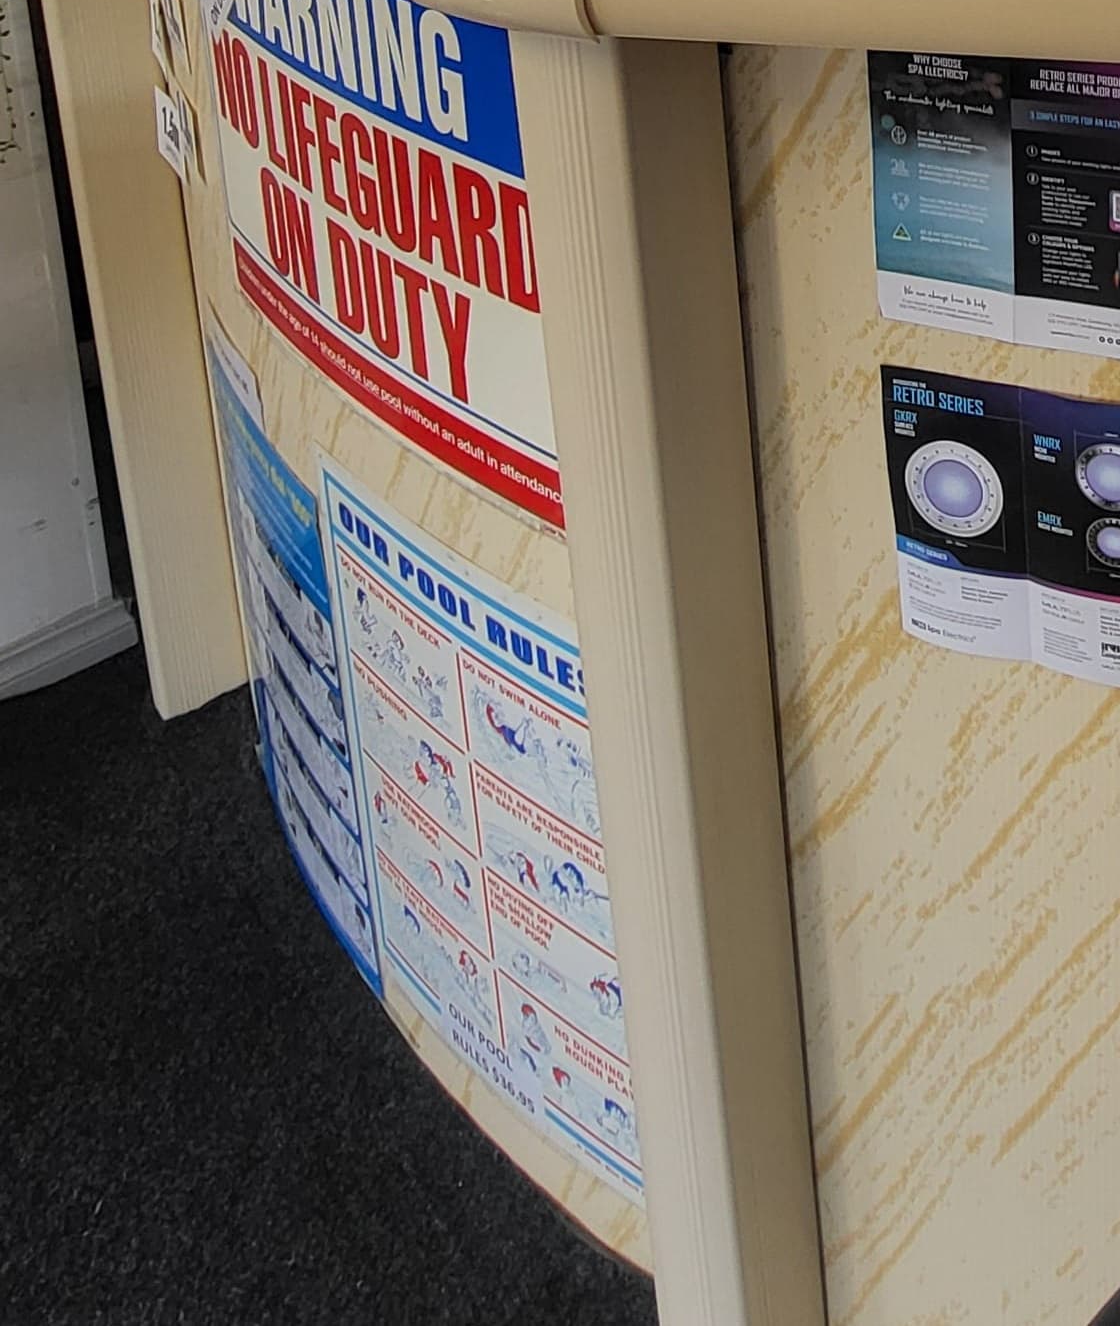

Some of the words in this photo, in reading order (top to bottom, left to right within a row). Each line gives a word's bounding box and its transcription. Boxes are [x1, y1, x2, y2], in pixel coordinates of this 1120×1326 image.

[210, 0, 221, 26] ON
[907, 63, 923, 75] SPA
[924, 65, 969, 82] ELECTRICS?
[912, 53, 930, 67] WHY
[931, 55, 962, 71] CHOOSE
[1030, 79, 1065, 93] REPLACE
[1066, 82, 1081, 95] ALL
[1082, 84, 1111, 98] MAJOR
[1039, 68, 1065, 83] RETRO
[1066, 71, 1095, 86] SERIES
[213, 30, 260, 149] NO
[257, 56, 541, 314] LIFEGUARD
[260, 167, 320, 305] ON
[326, 216, 471, 405] DUTY
[320, 340, 346, 370] should
[347, 363, 362, 383] not
[363, 375, 380, 396] use
[380, 388, 402, 412] pool
[403, 403, 440, 436] without
[441, 428, 456, 447] an
[457, 437, 485, 463] adult
[486, 452, 499, 471] in
[500, 462, 564, 504] attendanc
[893, 385, 935, 407] RETRO
[938, 392, 984, 416] SERIES
[339, 501, 390, 566] OUR
[398, 550, 477, 632] POOL
[399, 605, 415, 628] THE
[416, 621, 442, 651] DECK
[366, 674, 408, 722] PUSHING
[462, 658, 475, 675] DO
[477, 667, 497, 689] NOT
[498, 681, 527, 707] SWIM
[528, 700, 563, 730] ALONE
[475, 769, 513, 806] PARENTS
[515, 796, 534, 820] ARE
[535, 810, 602, 863] RESPONSIBLE
[476, 783, 494, 803] FOR
[495, 792, 530, 828] SAFETY
[531, 819, 543, 836] OF
[546, 829, 574, 856] THEIR
[575, 848, 605, 876] CHILD
[487, 874, 501, 893] NO
[503, 883, 534, 914] DIVING
[536, 908, 555, 931] OFF
[488, 888, 505, 909] THE
[506, 898, 552, 942] SHALLOW
[489, 899, 507, 921] END
[508, 911, 523, 932] OF
[524, 922, 550, 952] POOL
[449, 1002, 477, 1039] OUR
[477, 1031, 513, 1073] POOL
[452, 1029, 490, 1074] RULES
[554, 1025, 570, 1044] NO
[572, 1037, 625, 1083] DUNKING
[564, 1044, 604, 1080] ROUGH
